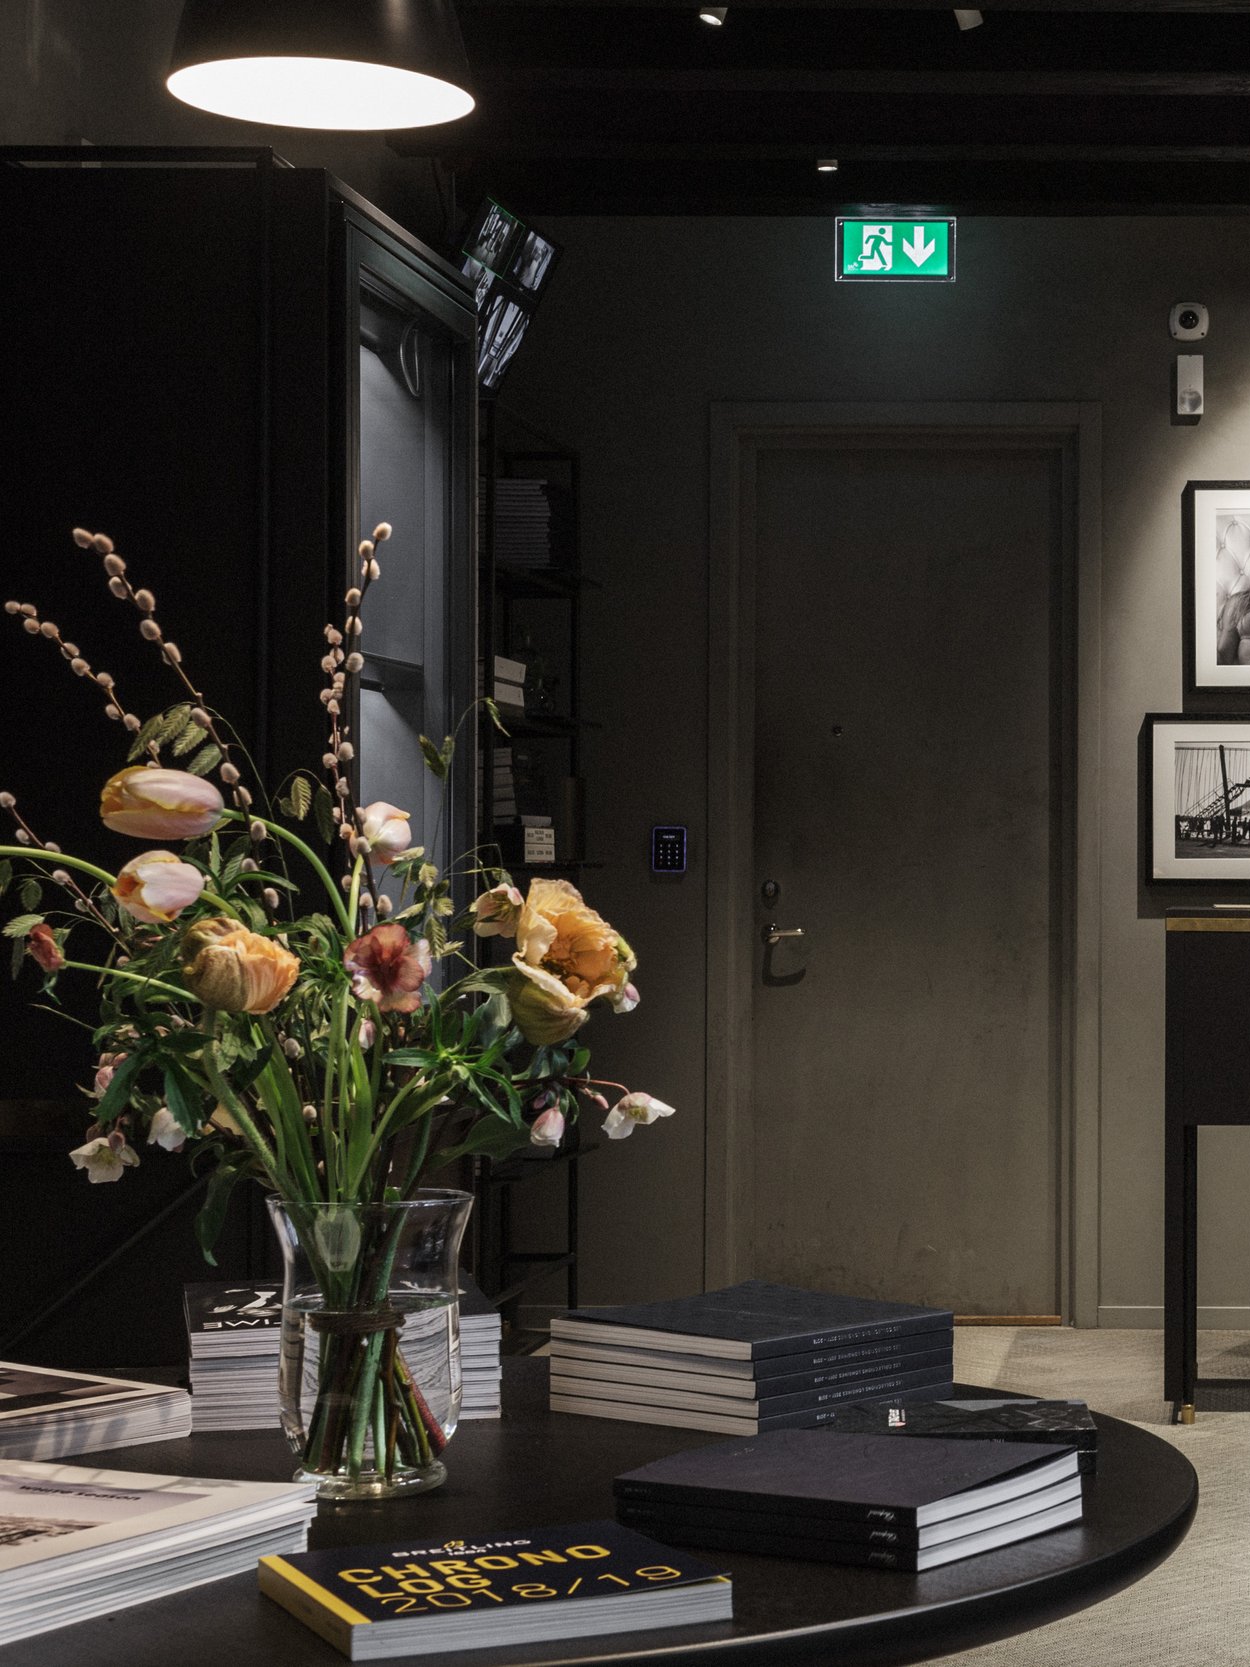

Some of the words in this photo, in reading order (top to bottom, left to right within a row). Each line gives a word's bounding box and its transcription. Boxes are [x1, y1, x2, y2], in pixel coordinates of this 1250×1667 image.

[338, 1544, 611, 1584] CHRONO
[391, 1539, 531, 1558] BREITLING
[357, 1574, 492, 1598] LOG
[381, 1565, 682, 1614] 2018/19
